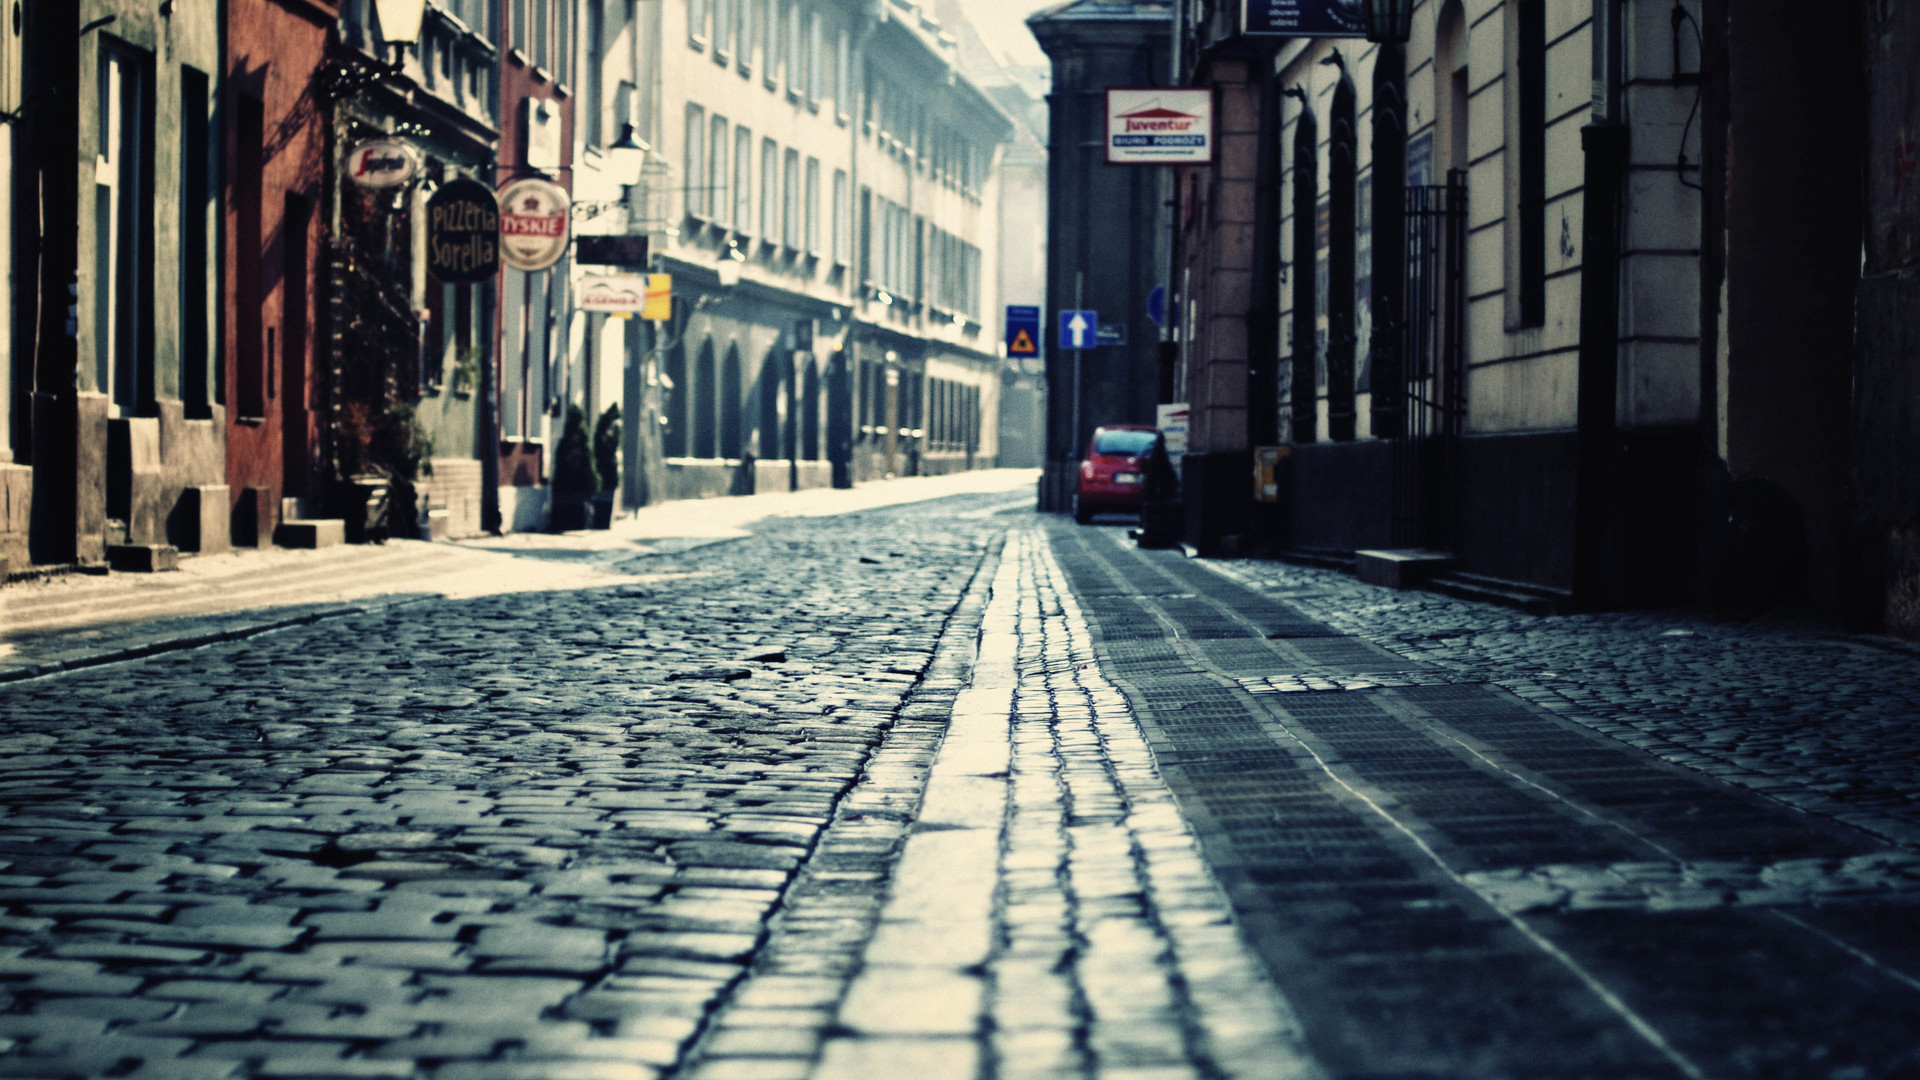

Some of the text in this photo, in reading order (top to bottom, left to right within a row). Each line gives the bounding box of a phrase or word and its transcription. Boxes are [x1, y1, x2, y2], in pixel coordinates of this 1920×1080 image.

[1115, 137, 1147, 145] BIURO
[503, 216, 557, 233] TYSKIE
[432, 233, 494, 272] Sorella
